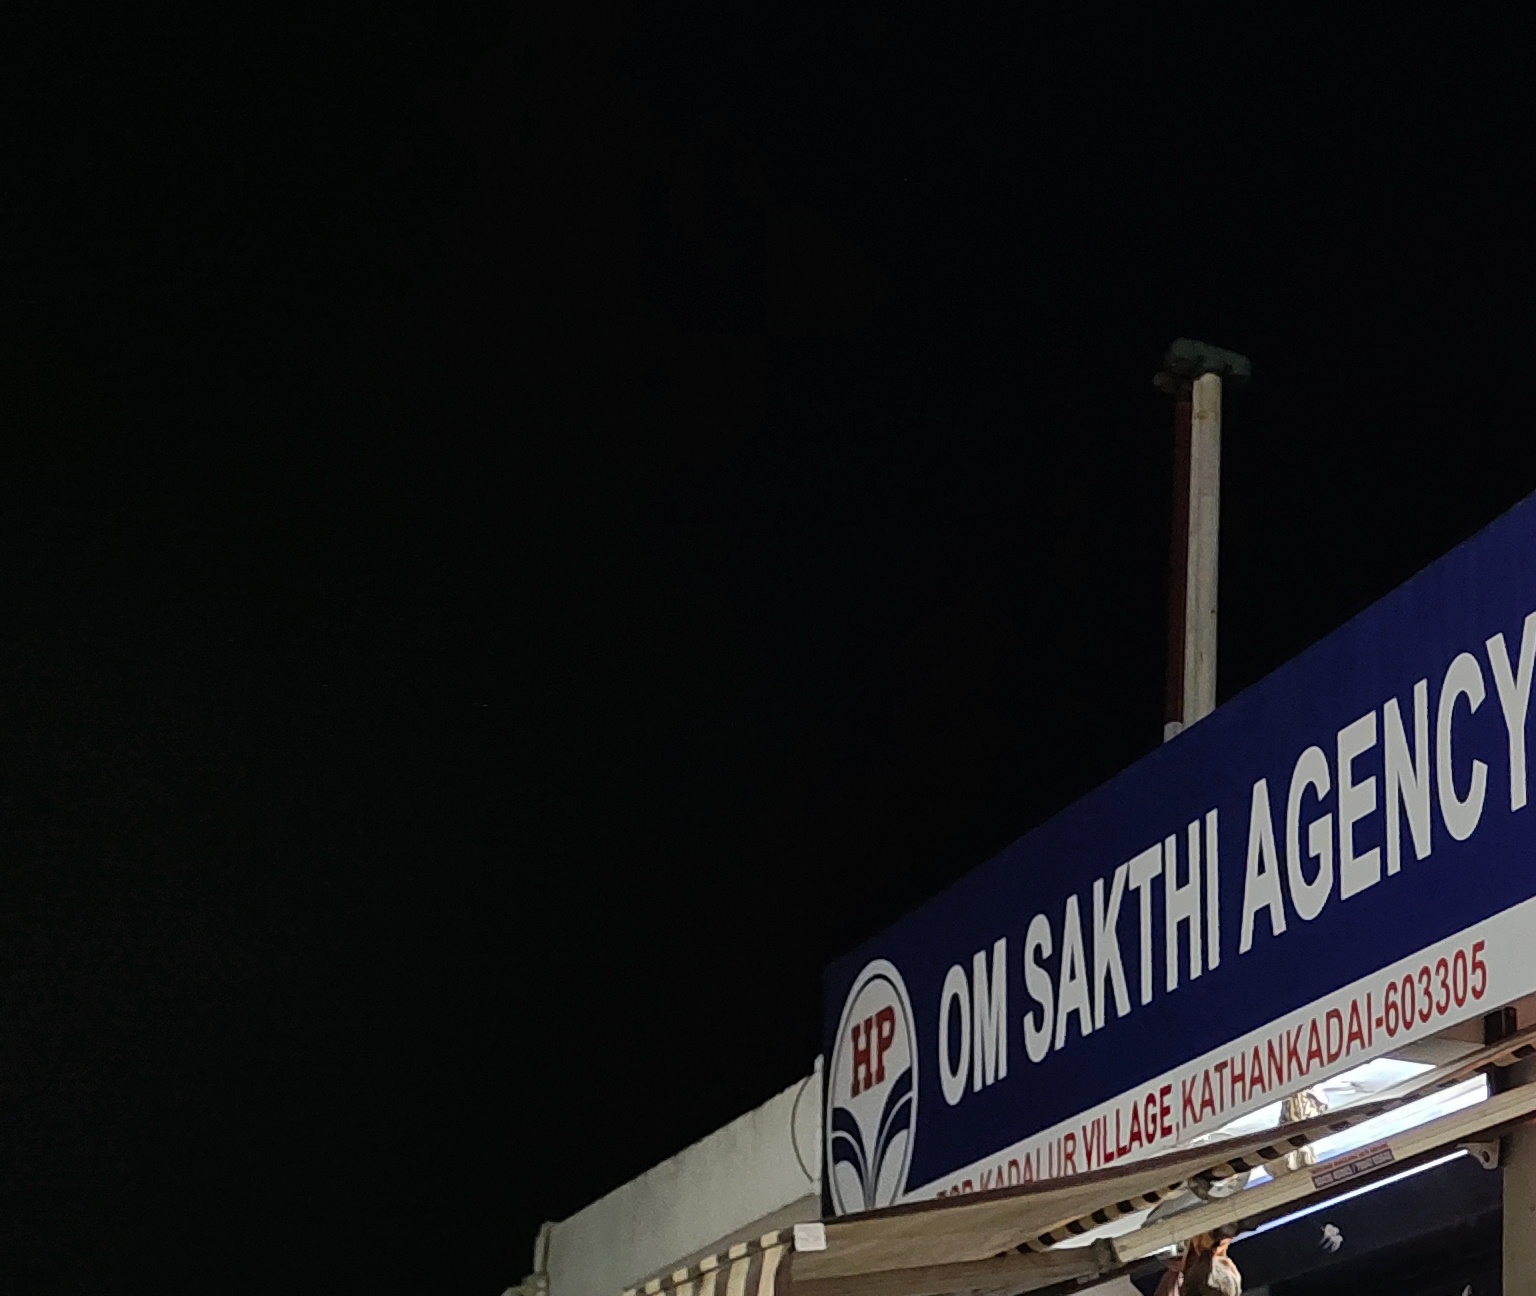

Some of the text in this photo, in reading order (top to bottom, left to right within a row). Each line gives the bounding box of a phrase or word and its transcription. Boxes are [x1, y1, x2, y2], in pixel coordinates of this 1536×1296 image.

[850, 1005, 896, 1099] HP
[938, 936, 1010, 1106] OM
[1024, 808, 1221, 1063] SAKTHI
